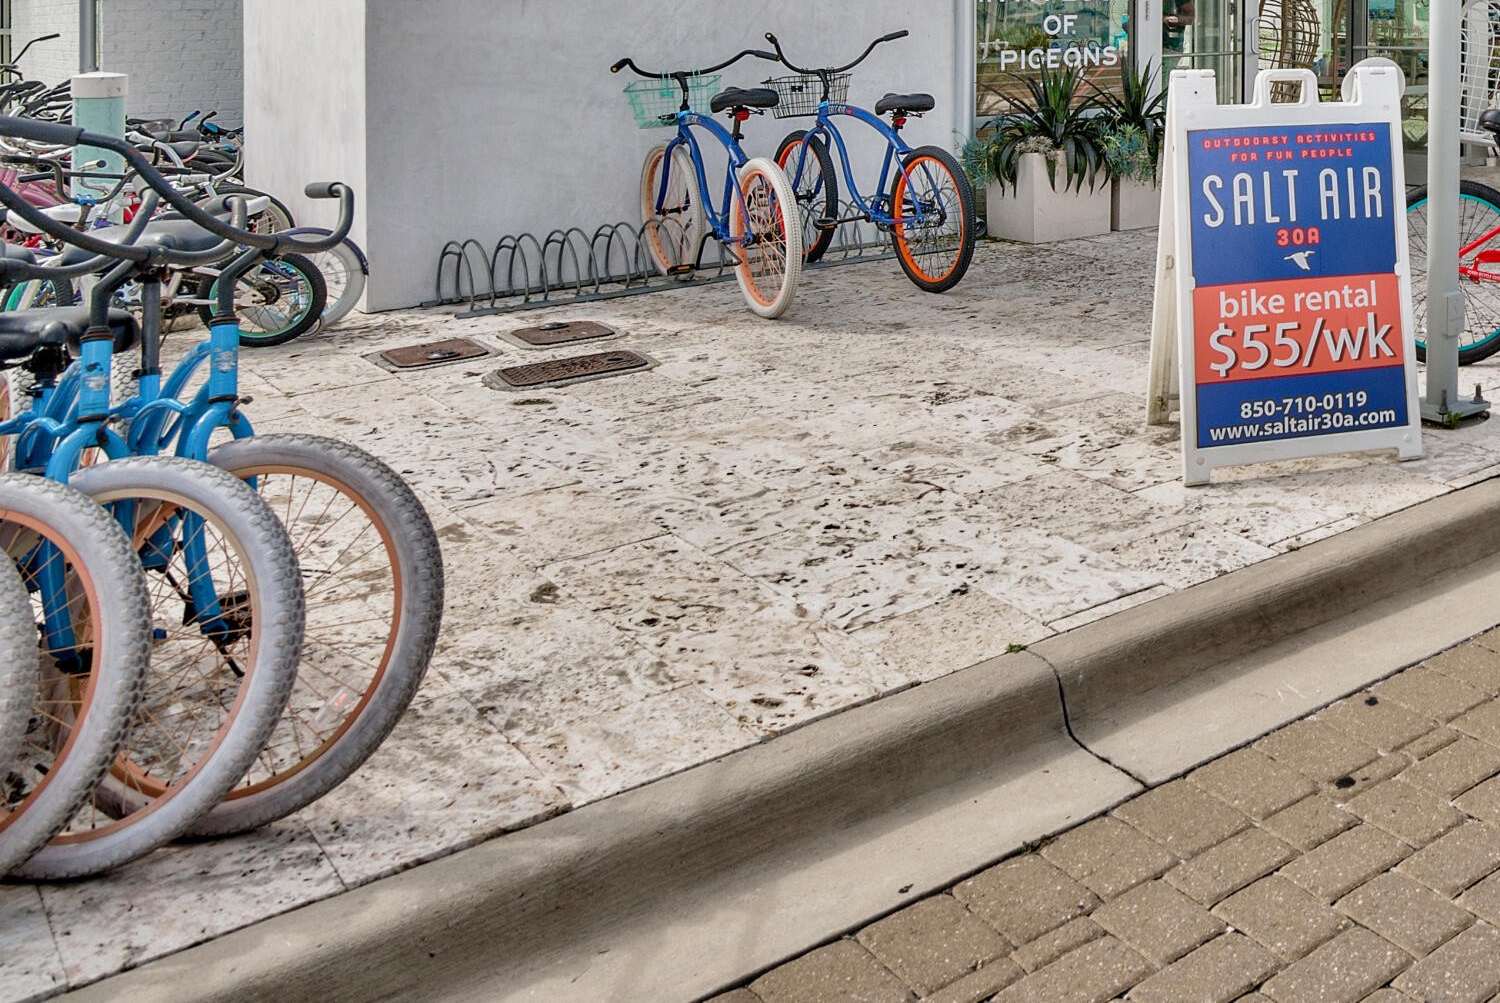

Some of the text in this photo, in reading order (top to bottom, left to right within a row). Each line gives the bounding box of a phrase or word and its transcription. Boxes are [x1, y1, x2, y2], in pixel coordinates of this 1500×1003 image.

[1043, 15, 1078, 35] OF
[1000, 46, 1118, 71] PIGEONS
[1203, 132, 1376, 149] OUTDOORSY ACTIVITIES
[1230, 148, 1353, 163] FOR FUN PEOPLE
[1202, 166, 1383, 227] SALT AIR
[1276, 226, 1320, 247] 30A
[1219, 280, 1377, 318] bike rental
[1209, 312, 1395, 377] $55/wk
[1240, 391, 1367, 419] 850-710-0119
[1209, 409, 1396, 441] www.saltair30a.com
